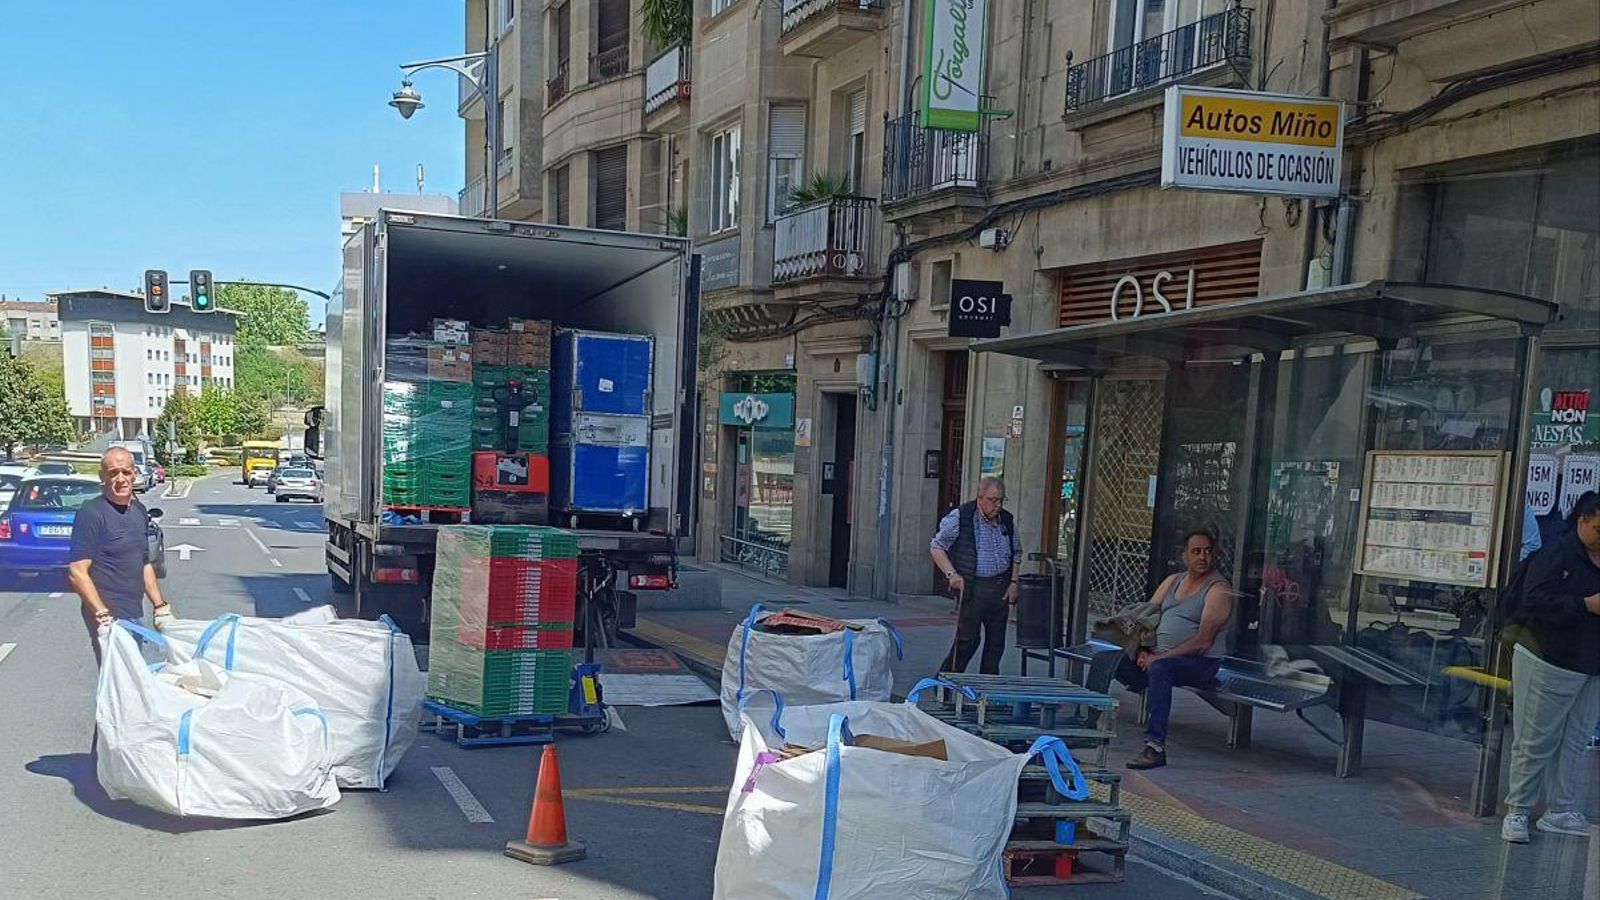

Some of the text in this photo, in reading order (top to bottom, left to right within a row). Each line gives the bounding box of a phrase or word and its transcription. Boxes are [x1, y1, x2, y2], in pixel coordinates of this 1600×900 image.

[1186, 105, 1333, 139] Autos Miño
[1179, 143, 1335, 184] VEHÍCULOS DE OCASIÓN
[1111, 268, 1195, 322] OSI
[959, 296, 996, 314] OSI
[1551, 409, 1586, 422] NON
[1532, 425, 1583, 442] NESTAS
[1530, 465, 1551, 482] 15M
[1571, 468, 1593, 485] 15M
[1526, 490, 1550, 507] NKB
